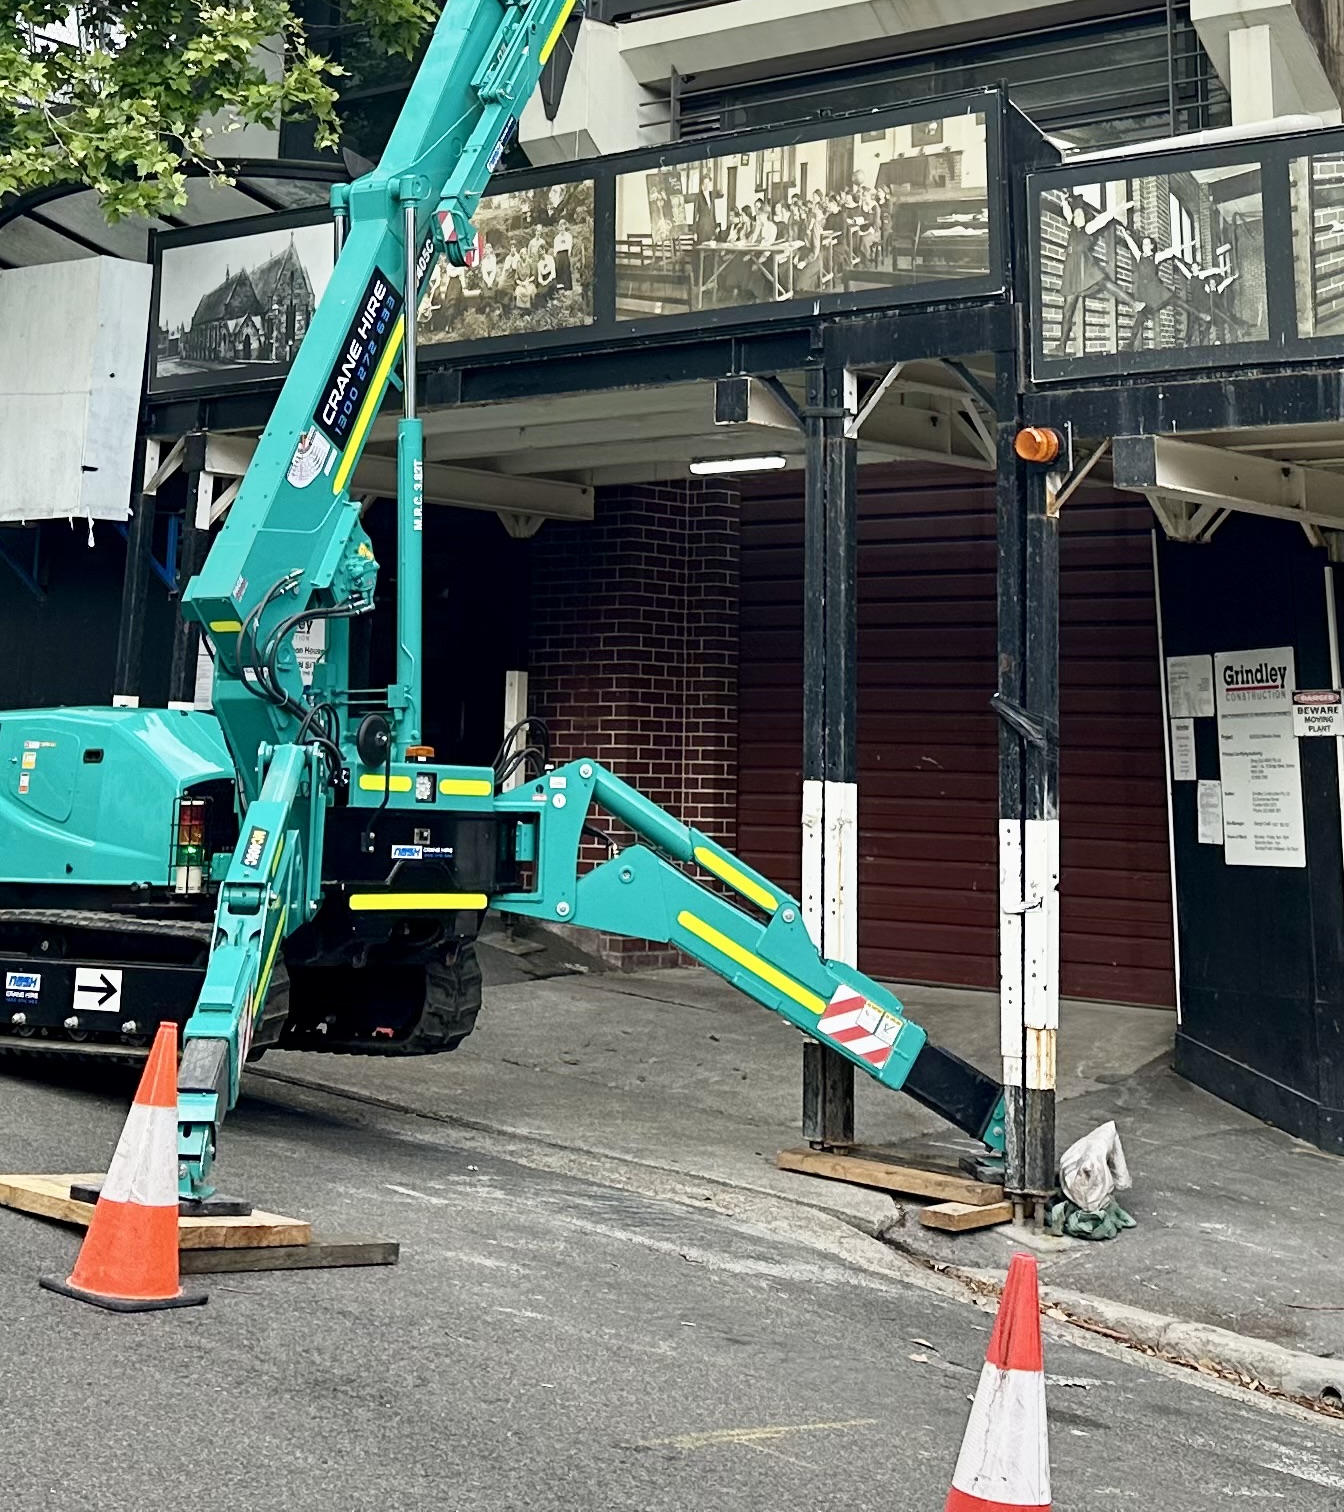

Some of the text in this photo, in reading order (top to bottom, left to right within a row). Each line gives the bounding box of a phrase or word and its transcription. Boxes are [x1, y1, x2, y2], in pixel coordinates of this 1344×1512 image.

[322, 279, 387, 426] CRANE HIRE
[334, 295, 396, 436] 1300 272 633
[1223, 663, 1288, 689] Grindley
[1225, 690, 1287, 702] CONSTRUCTION
[1297, 706, 1339, 715] BEWARE
[1304, 716, 1334, 724] MOVING
[1308, 725, 1331, 733] PLANT
